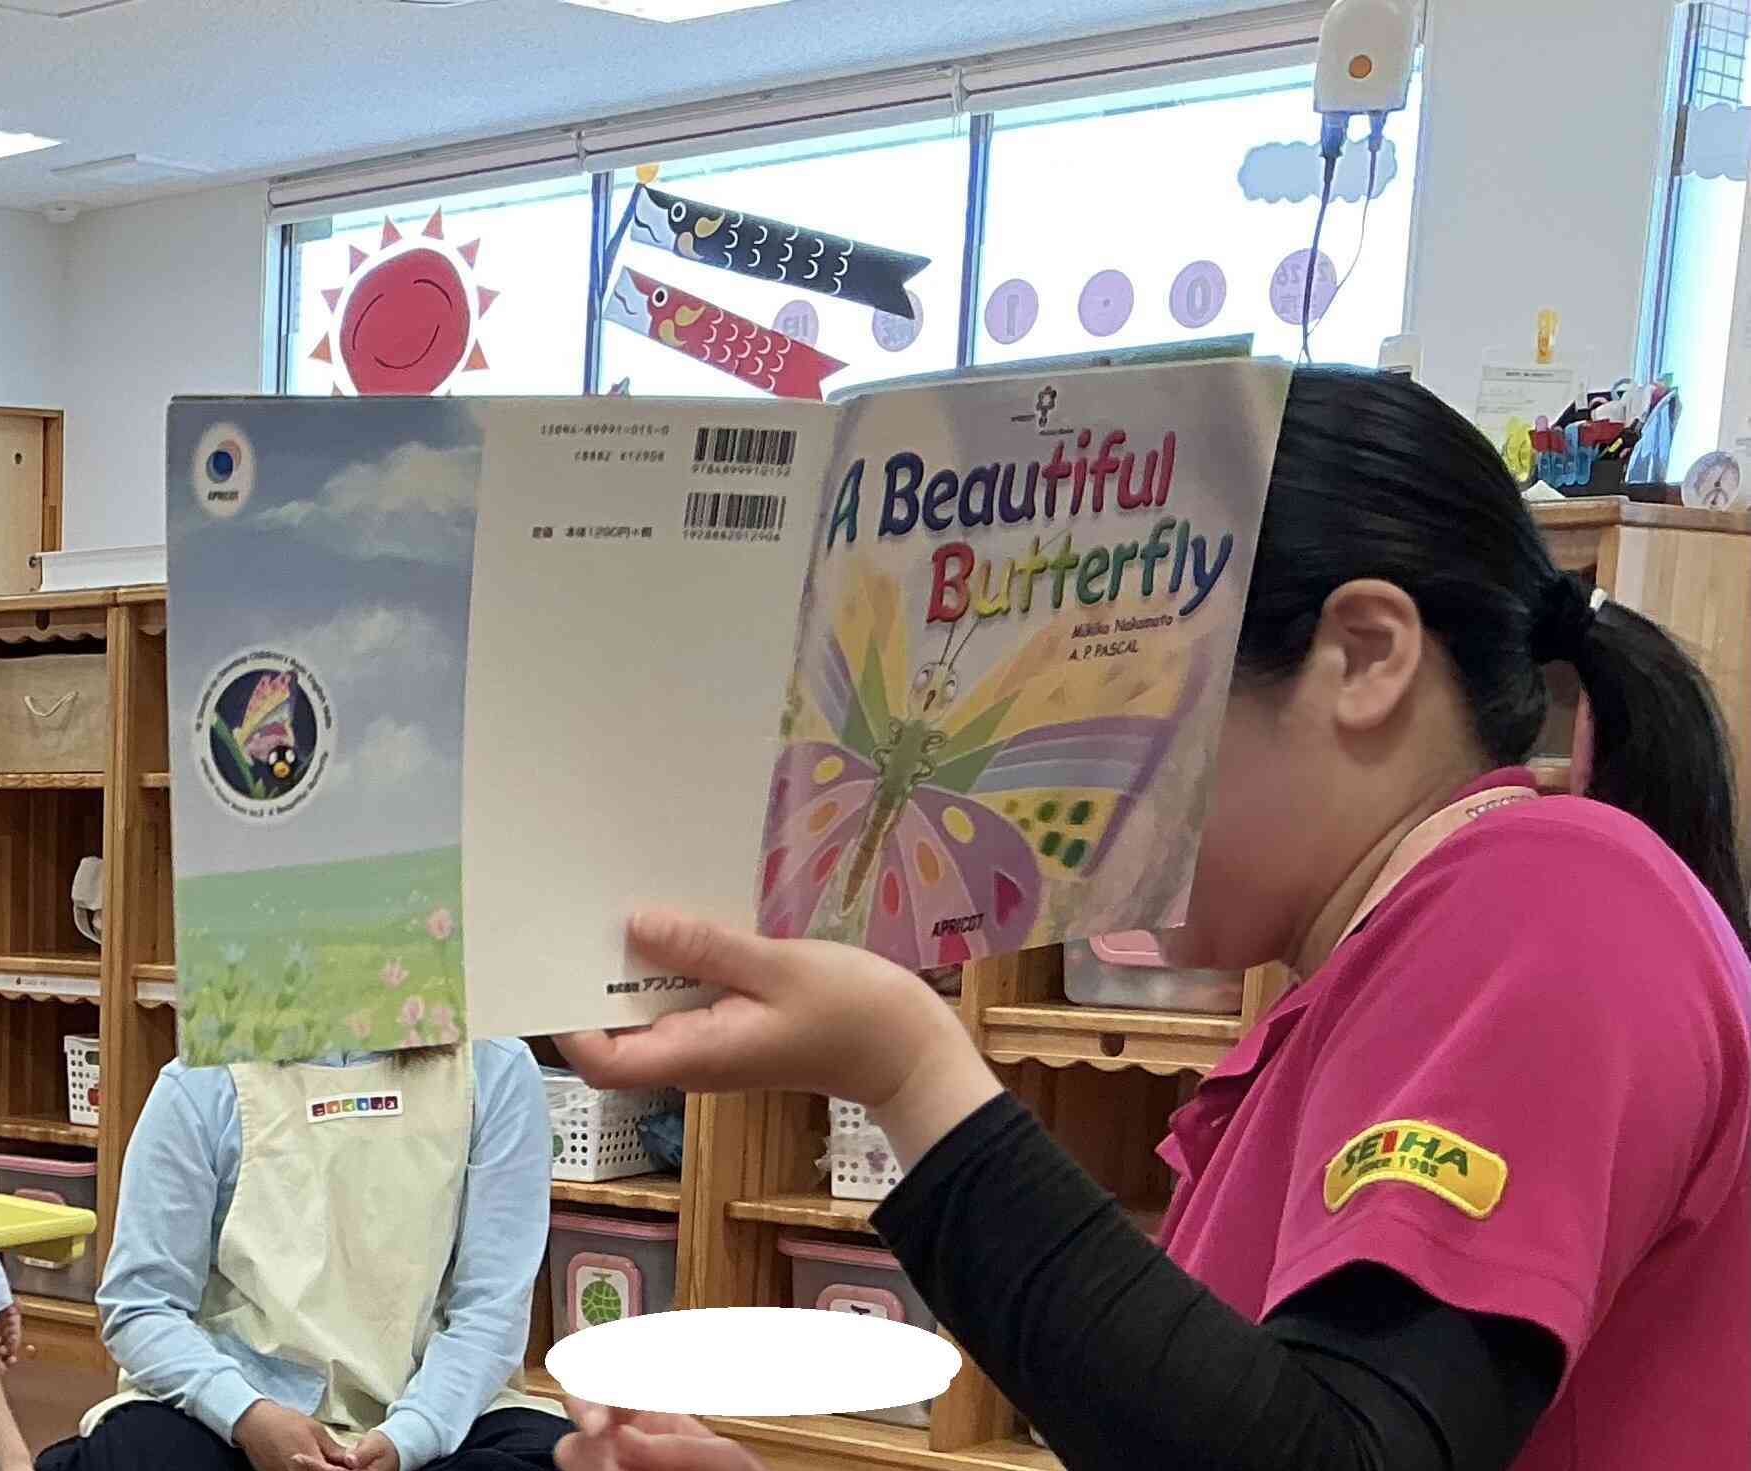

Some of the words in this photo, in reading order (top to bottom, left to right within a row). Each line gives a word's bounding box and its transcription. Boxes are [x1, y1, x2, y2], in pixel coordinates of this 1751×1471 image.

[827, 458, 866, 552] A
[877, 428, 1177, 538] Beautiful
[926, 515, 1234, 624] Butterfly
[1341, 1130, 1469, 1178] SEIHA
